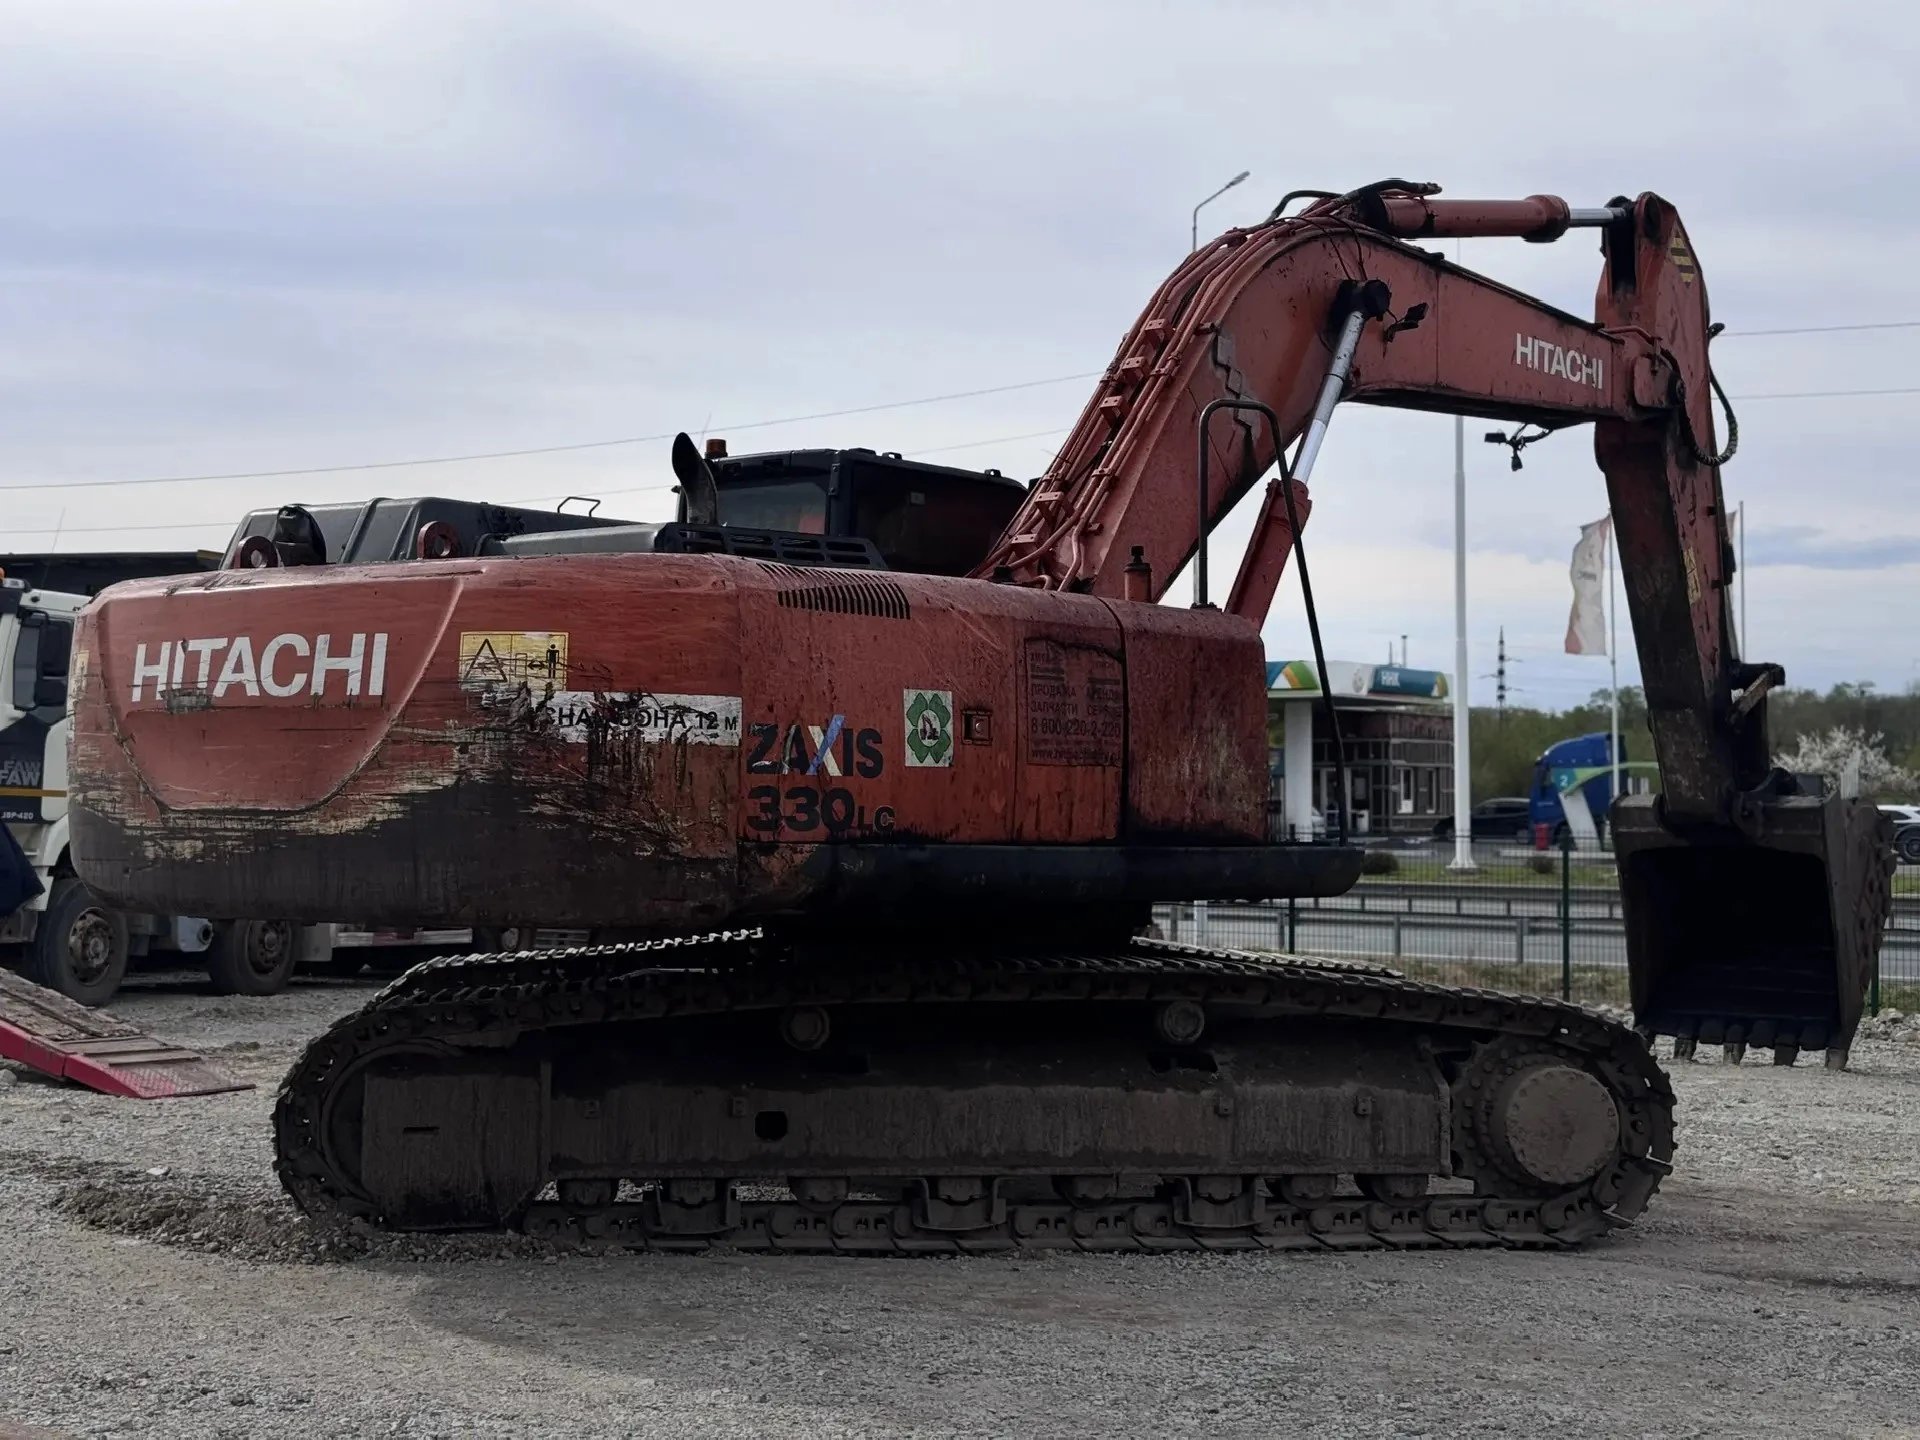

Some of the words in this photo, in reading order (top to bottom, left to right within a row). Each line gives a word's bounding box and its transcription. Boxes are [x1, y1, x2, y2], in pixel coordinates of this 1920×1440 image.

[1516, 333, 1602, 388] HITACHI
[132, 633, 388, 702] HITACHI
[747, 714, 883, 778] ZAXIS
[0, 770, 40, 787] FAW
